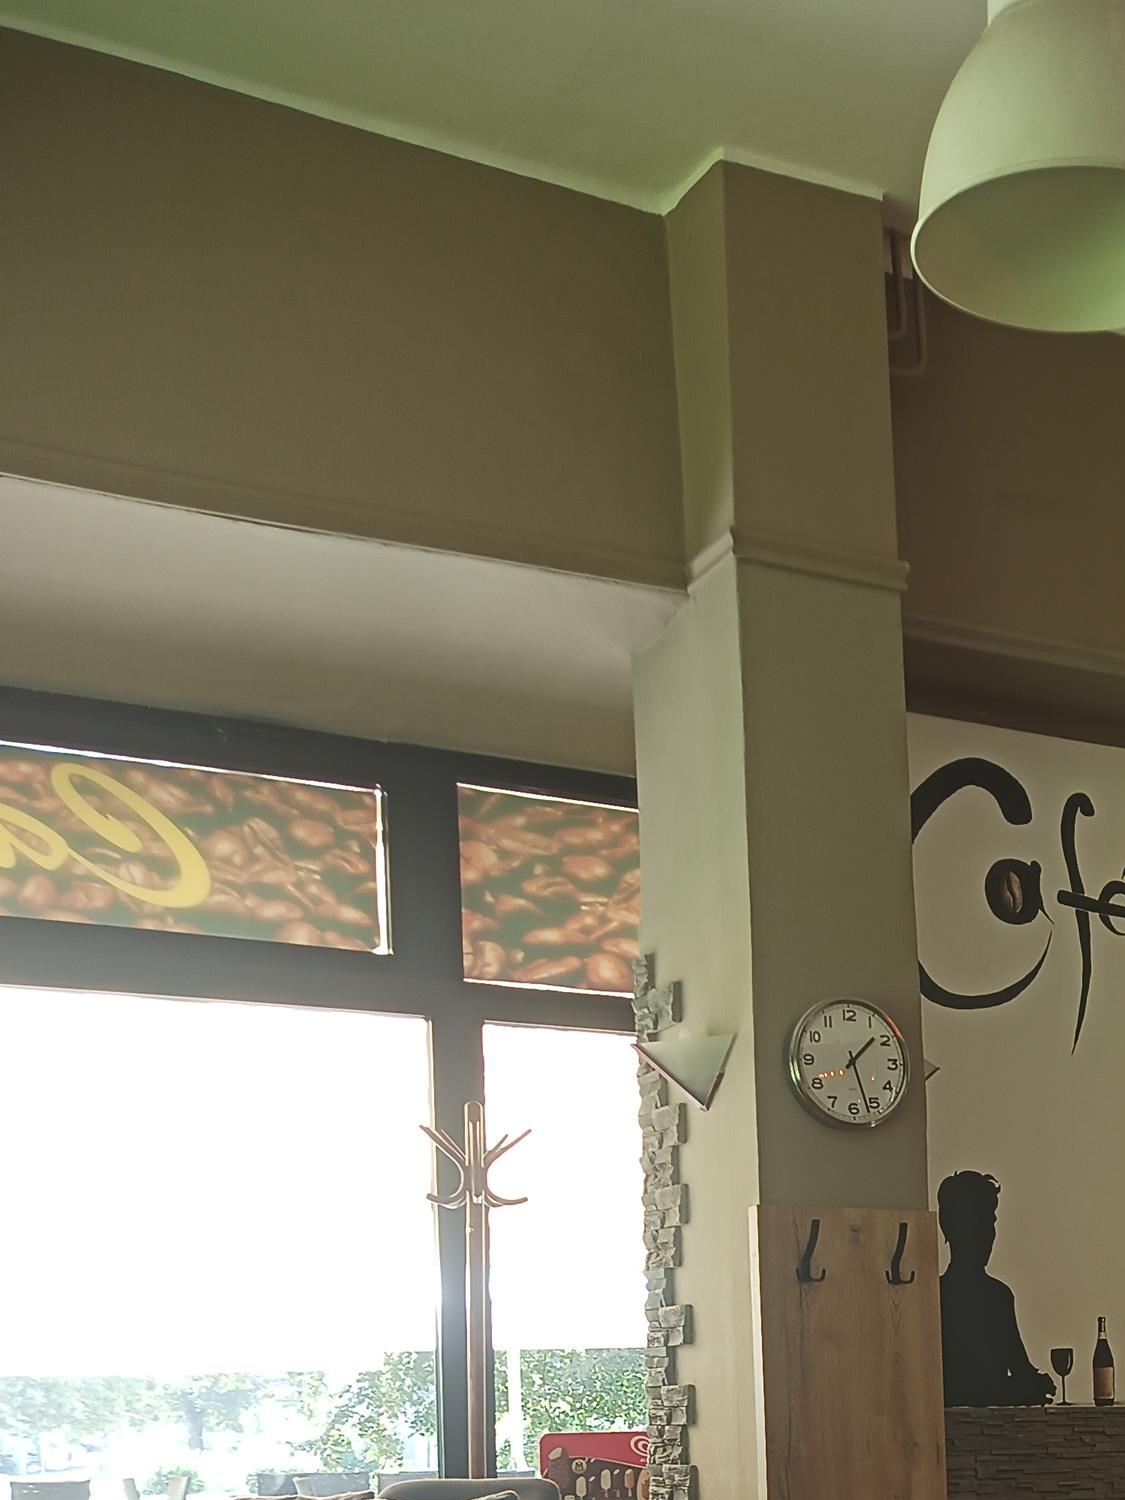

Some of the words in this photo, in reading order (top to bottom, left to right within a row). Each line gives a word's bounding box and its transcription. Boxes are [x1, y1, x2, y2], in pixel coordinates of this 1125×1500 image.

[823, 1015, 833, 1028] 11
[842, 1009, 857, 1022] 12
[809, 1031, 821, 1043] 10
[879, 1034, 891, 1047] 2
[802, 1053, 815, 1066] 9
[887, 1058, 898, 1071] 3
[811, 1077, 824, 1090] 8
[882, 1080, 894, 1093] 4
[827, 1095, 838, 1109] 7
[847, 1102, 860, 1115] 6
[868, 1097, 881, 1110] 5
